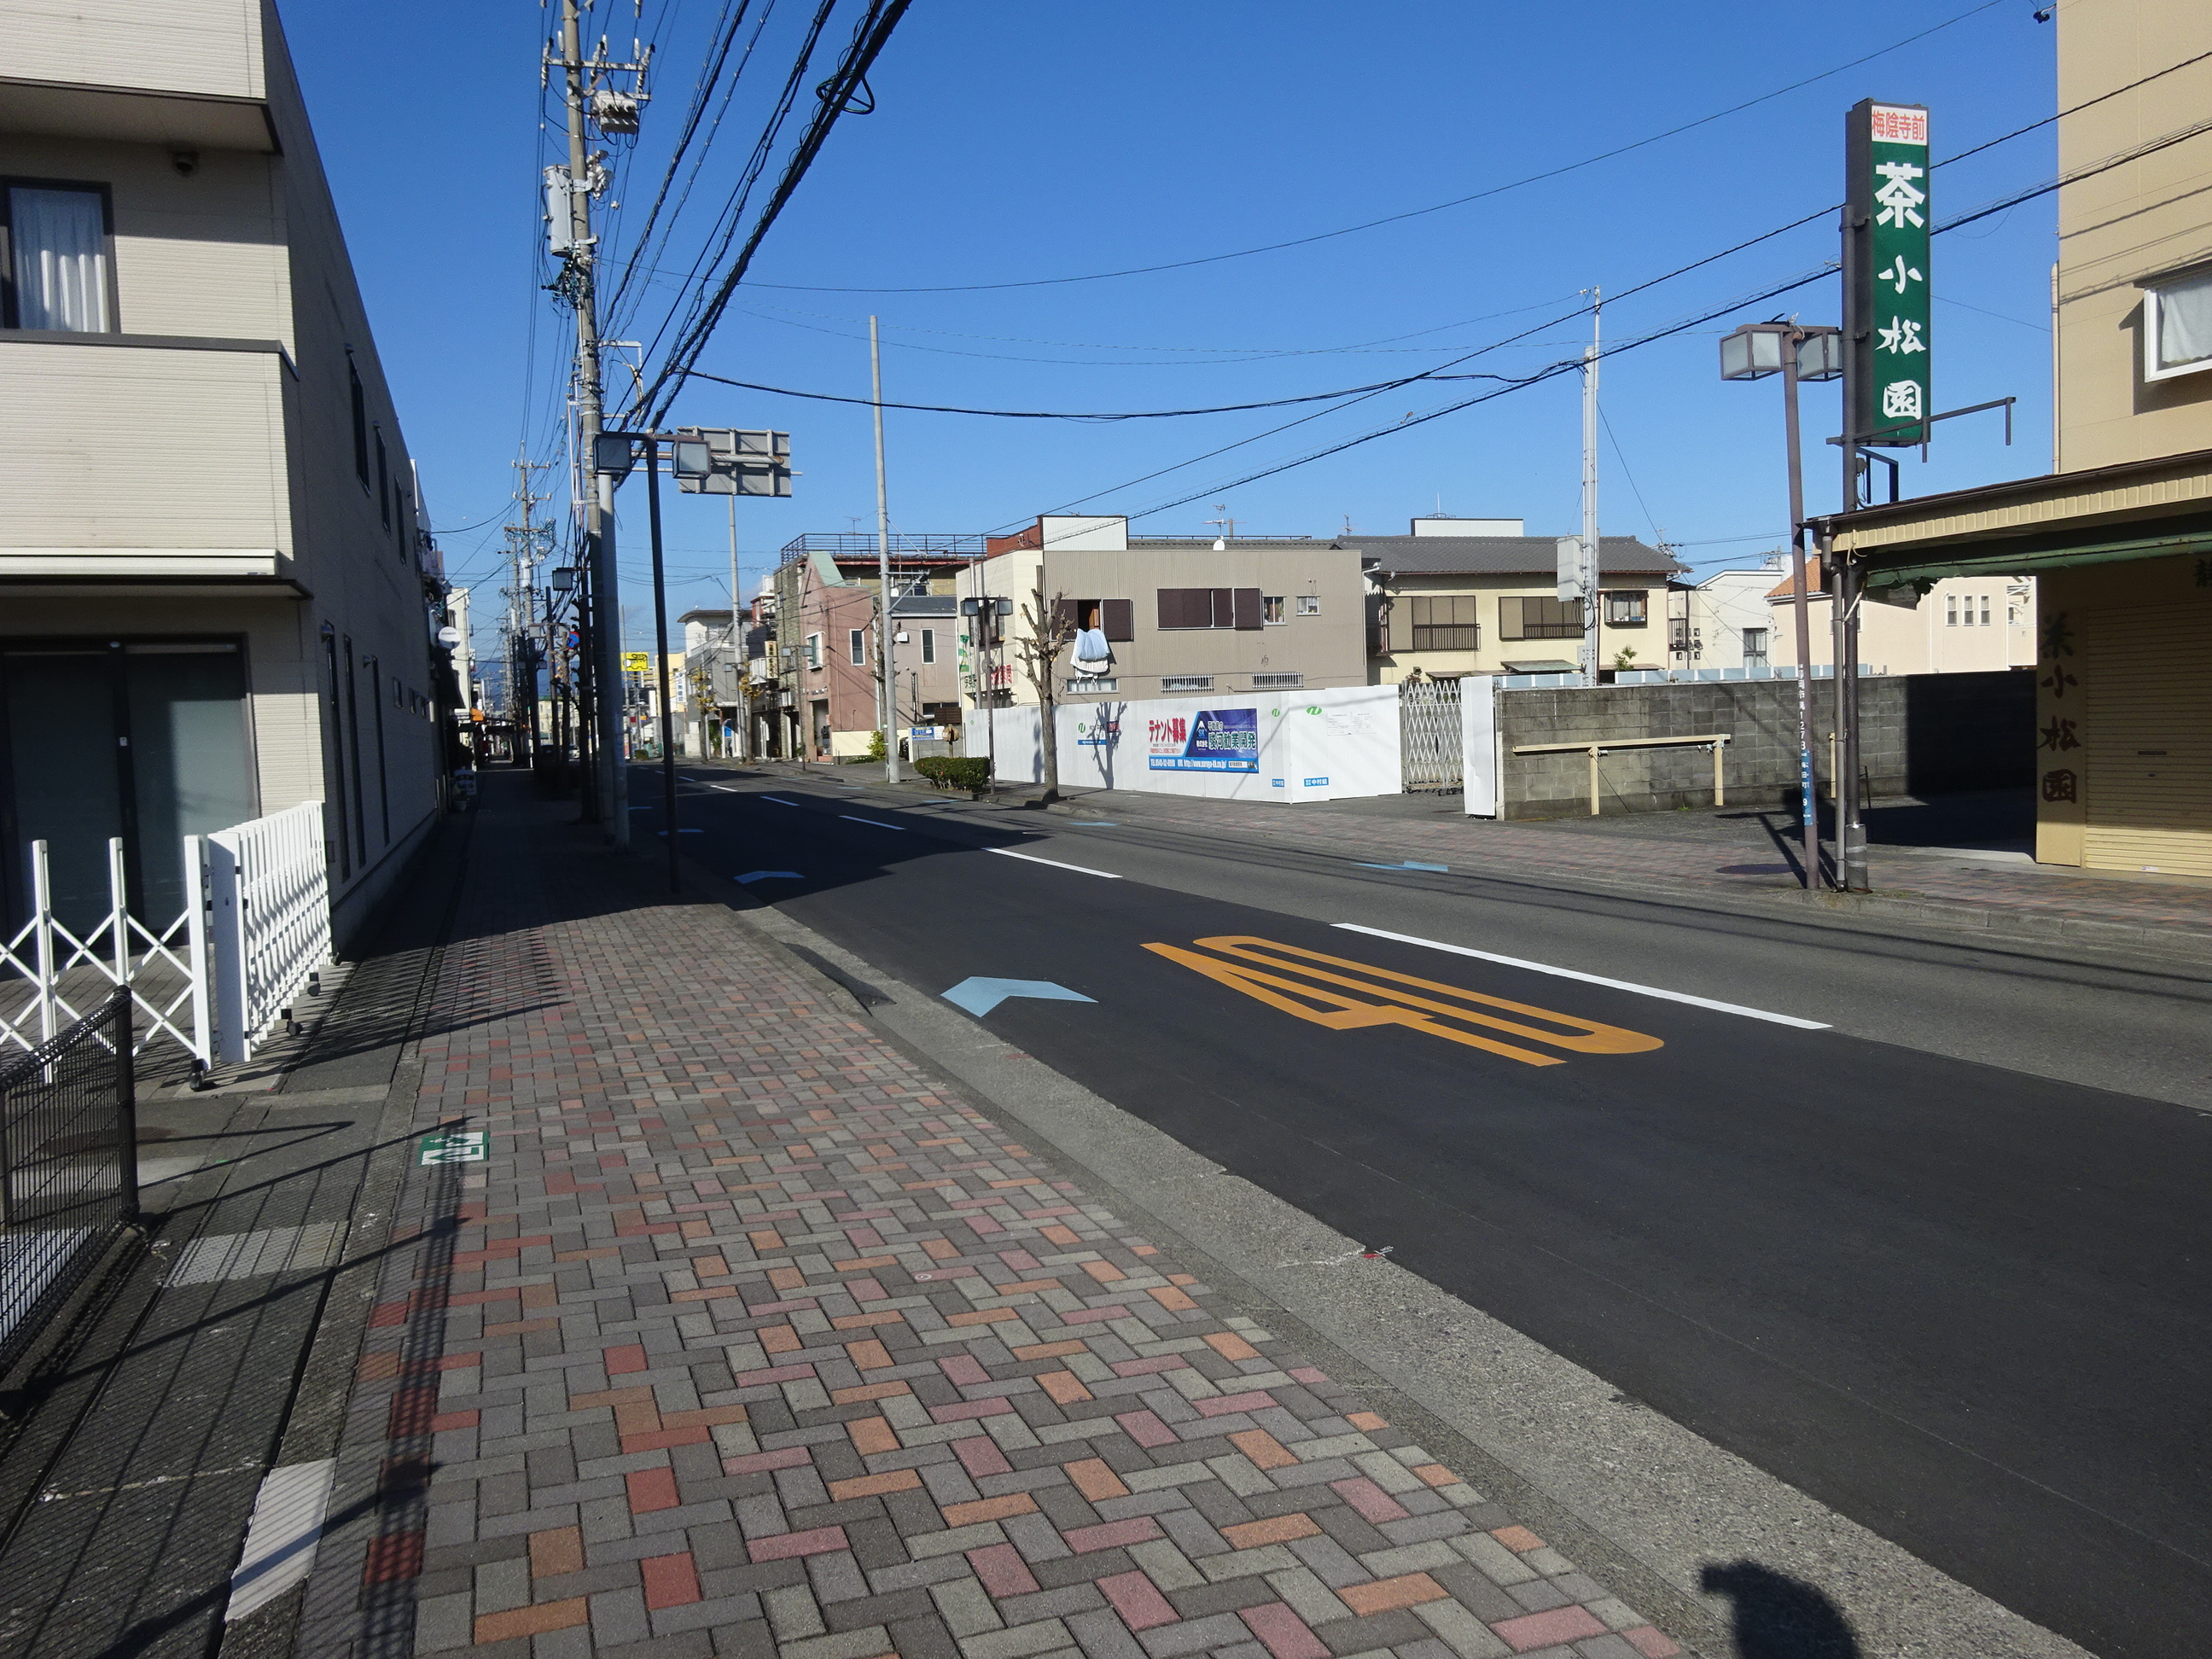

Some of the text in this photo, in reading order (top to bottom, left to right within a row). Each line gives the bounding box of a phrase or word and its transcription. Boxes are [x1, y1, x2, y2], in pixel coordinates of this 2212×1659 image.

[1150, 718, 1186, 742] テナント募集
[1140, 935, 1665, 1067] 40
